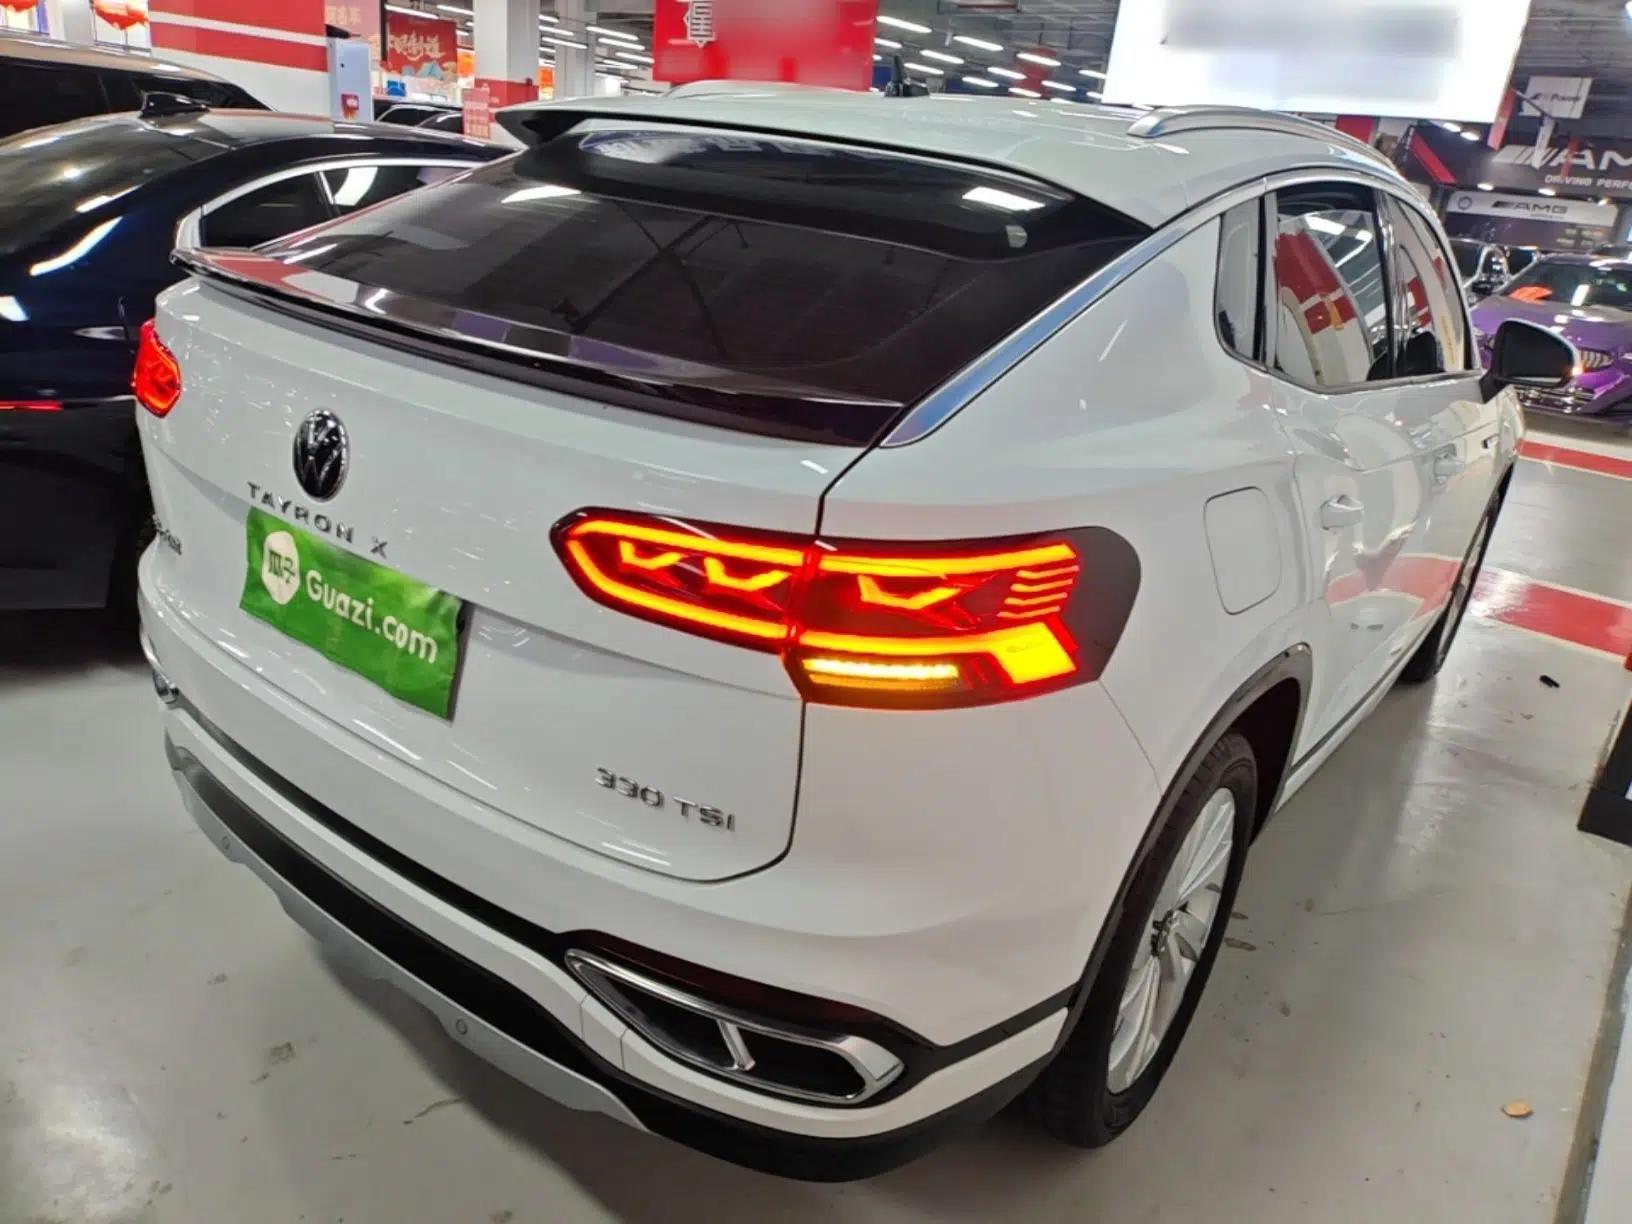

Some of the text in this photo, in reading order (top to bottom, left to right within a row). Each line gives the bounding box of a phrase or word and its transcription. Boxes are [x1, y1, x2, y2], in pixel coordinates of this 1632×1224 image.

[247, 481, 389, 559] TAYRON X
[305, 569, 438, 664] Guazi.com
[595, 767, 736, 832] 330 TSI
